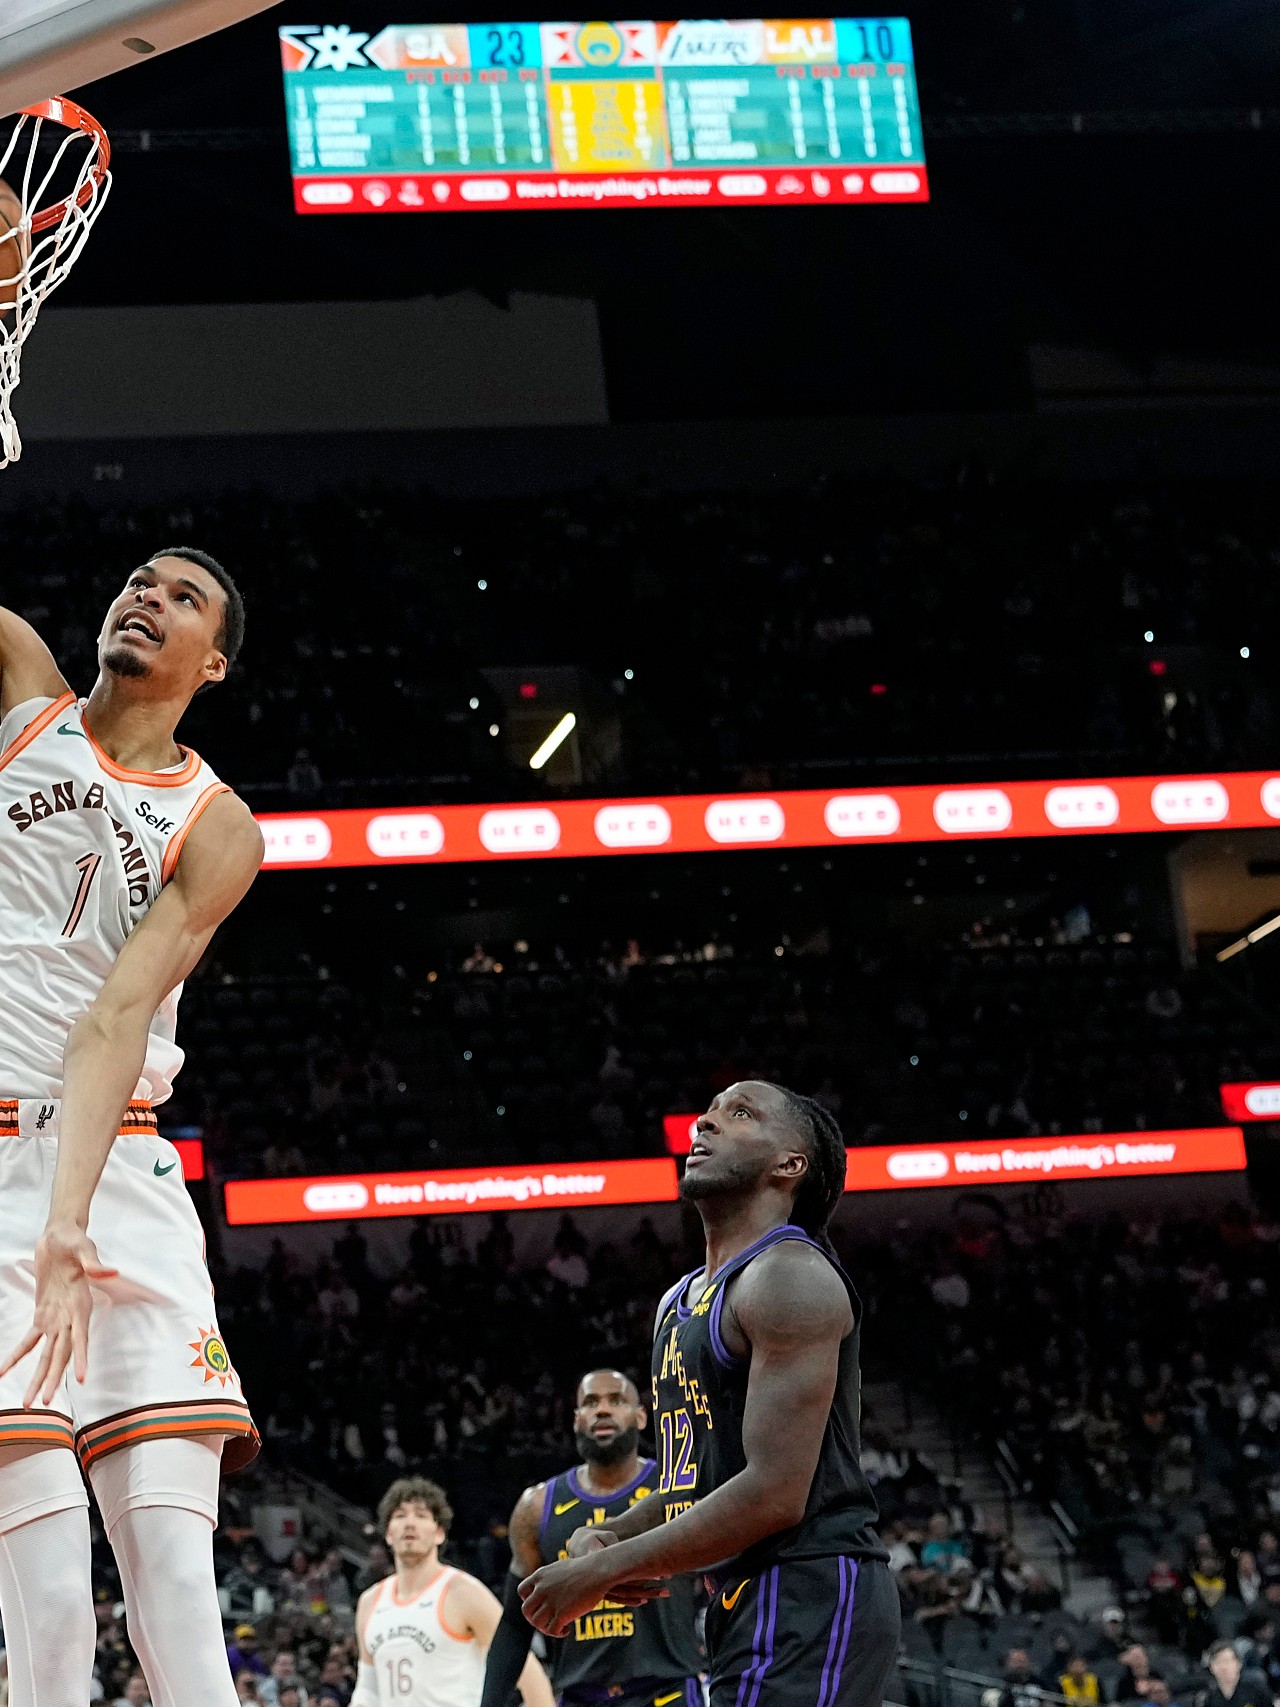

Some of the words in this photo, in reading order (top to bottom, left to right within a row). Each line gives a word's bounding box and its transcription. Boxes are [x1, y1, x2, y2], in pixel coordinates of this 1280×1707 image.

[487, 30, 525, 65] 23
[858, 25, 894, 60] 10
[8, 780, 77, 832] SAN
[135, 801, 176, 835] Self.
[61, 852, 102, 938] 1
[954, 1151, 1001, 1173] Here
[1002, 1145, 1115, 1172] Everything's
[1116, 1142, 1176, 1165] Better
[374, 1184, 422, 1204] Here
[424, 1176, 541, 1204] Everything's
[542, 1174, 605, 1195] Better
[659, 1408, 697, 1494] 12
[574, 1612, 635, 1641] LAKERS
[387, 1658, 413, 1697] 16
